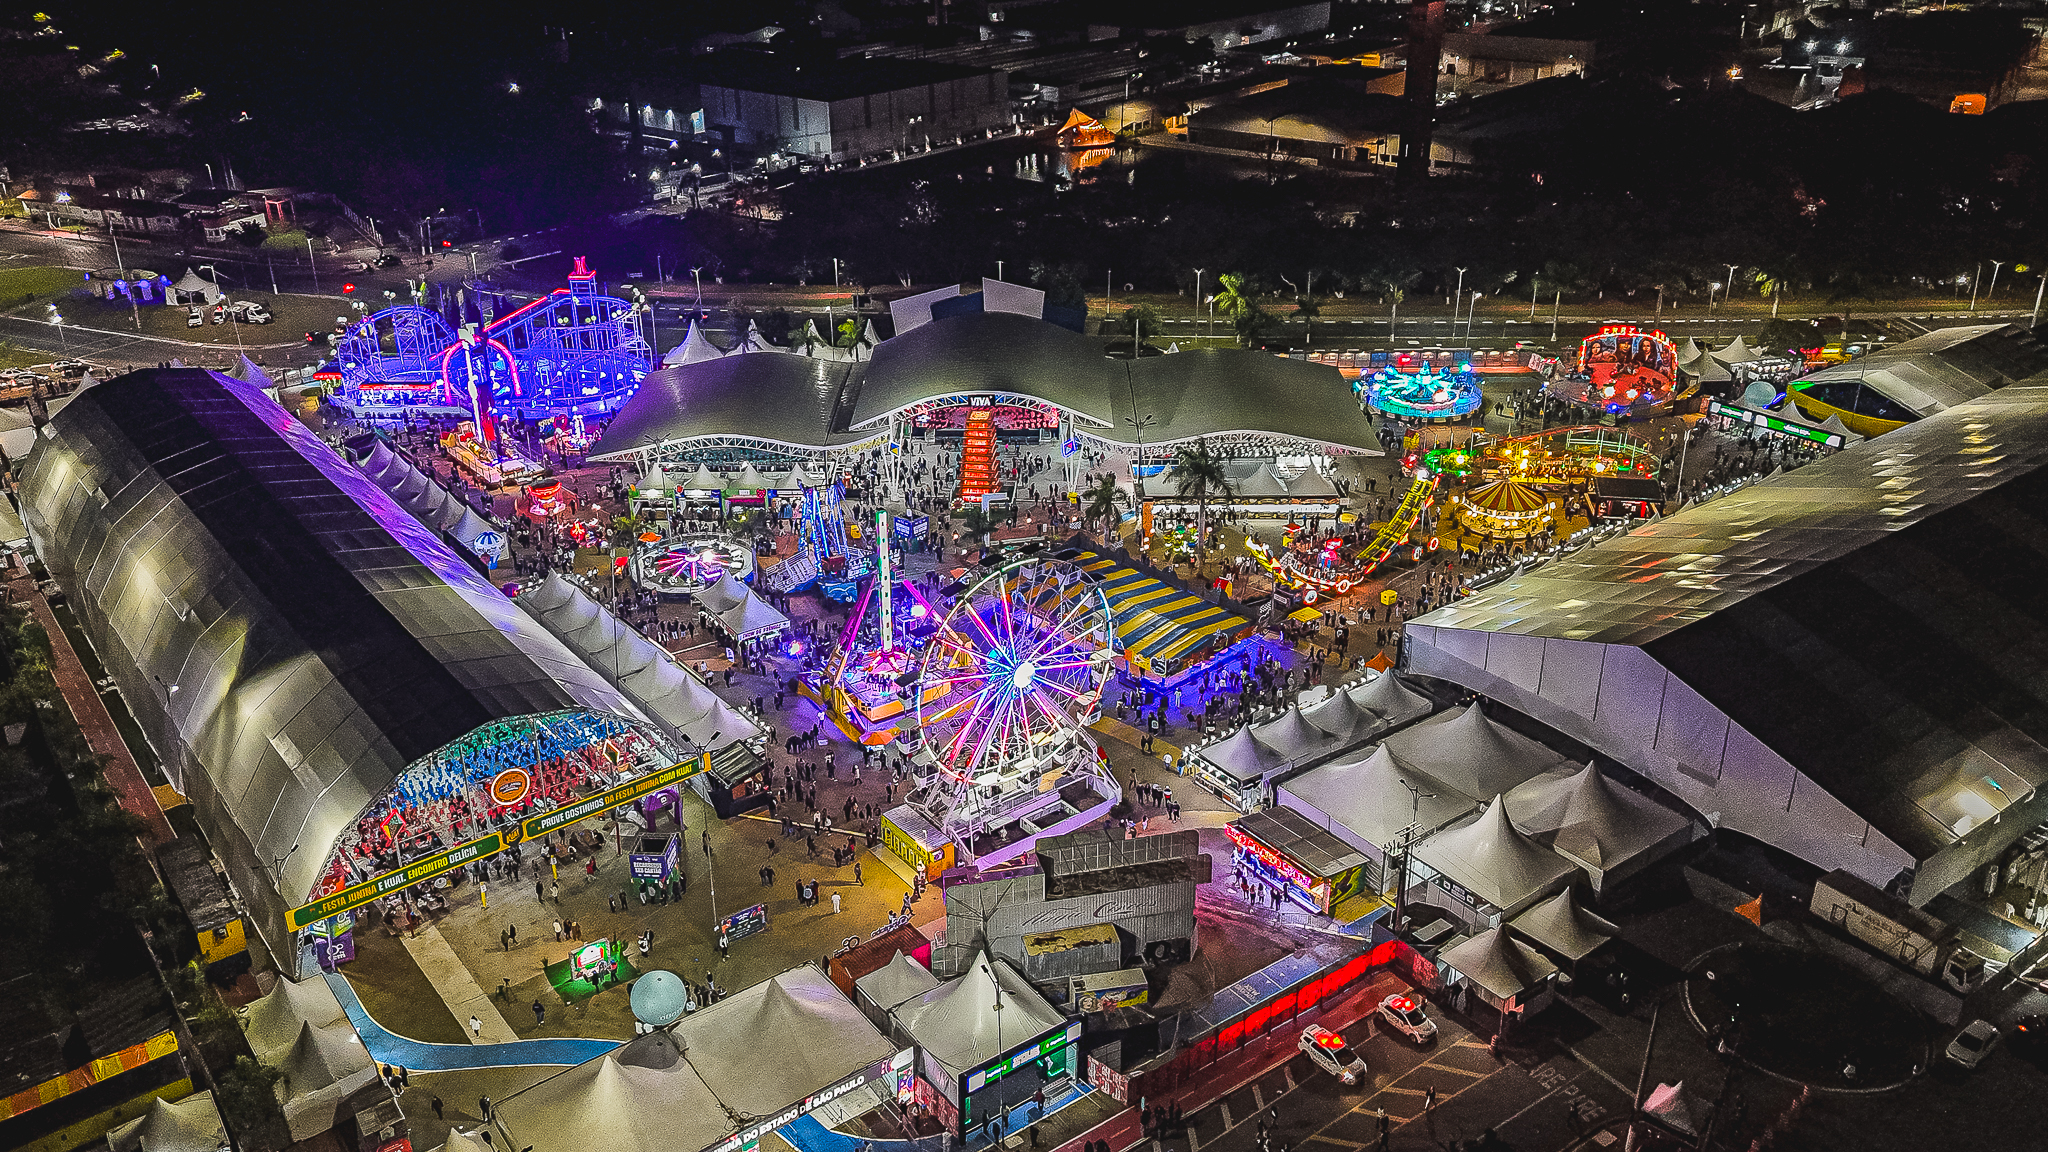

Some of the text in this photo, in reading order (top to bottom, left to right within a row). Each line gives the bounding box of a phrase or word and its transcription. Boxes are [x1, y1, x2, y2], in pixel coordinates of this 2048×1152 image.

[970, 397, 991, 406] VIVA
[541, 764, 694, 829] PROVE GOSTINHOS DA FESTA JUNINA COM KUAT
[506, 828, 520, 844] KUAT
[322, 845, 478, 913] FESTA JUNINA E KUAT. ENCONTRO DELÍCIA
[743, 1128, 759, 1143] DO
[759, 1109, 798, 1137] ESTADO
[799, 1101, 813, 1115] DE
[812, 1090, 834, 1109] SÃO
[834, 1075, 865, 1098] PAULO
